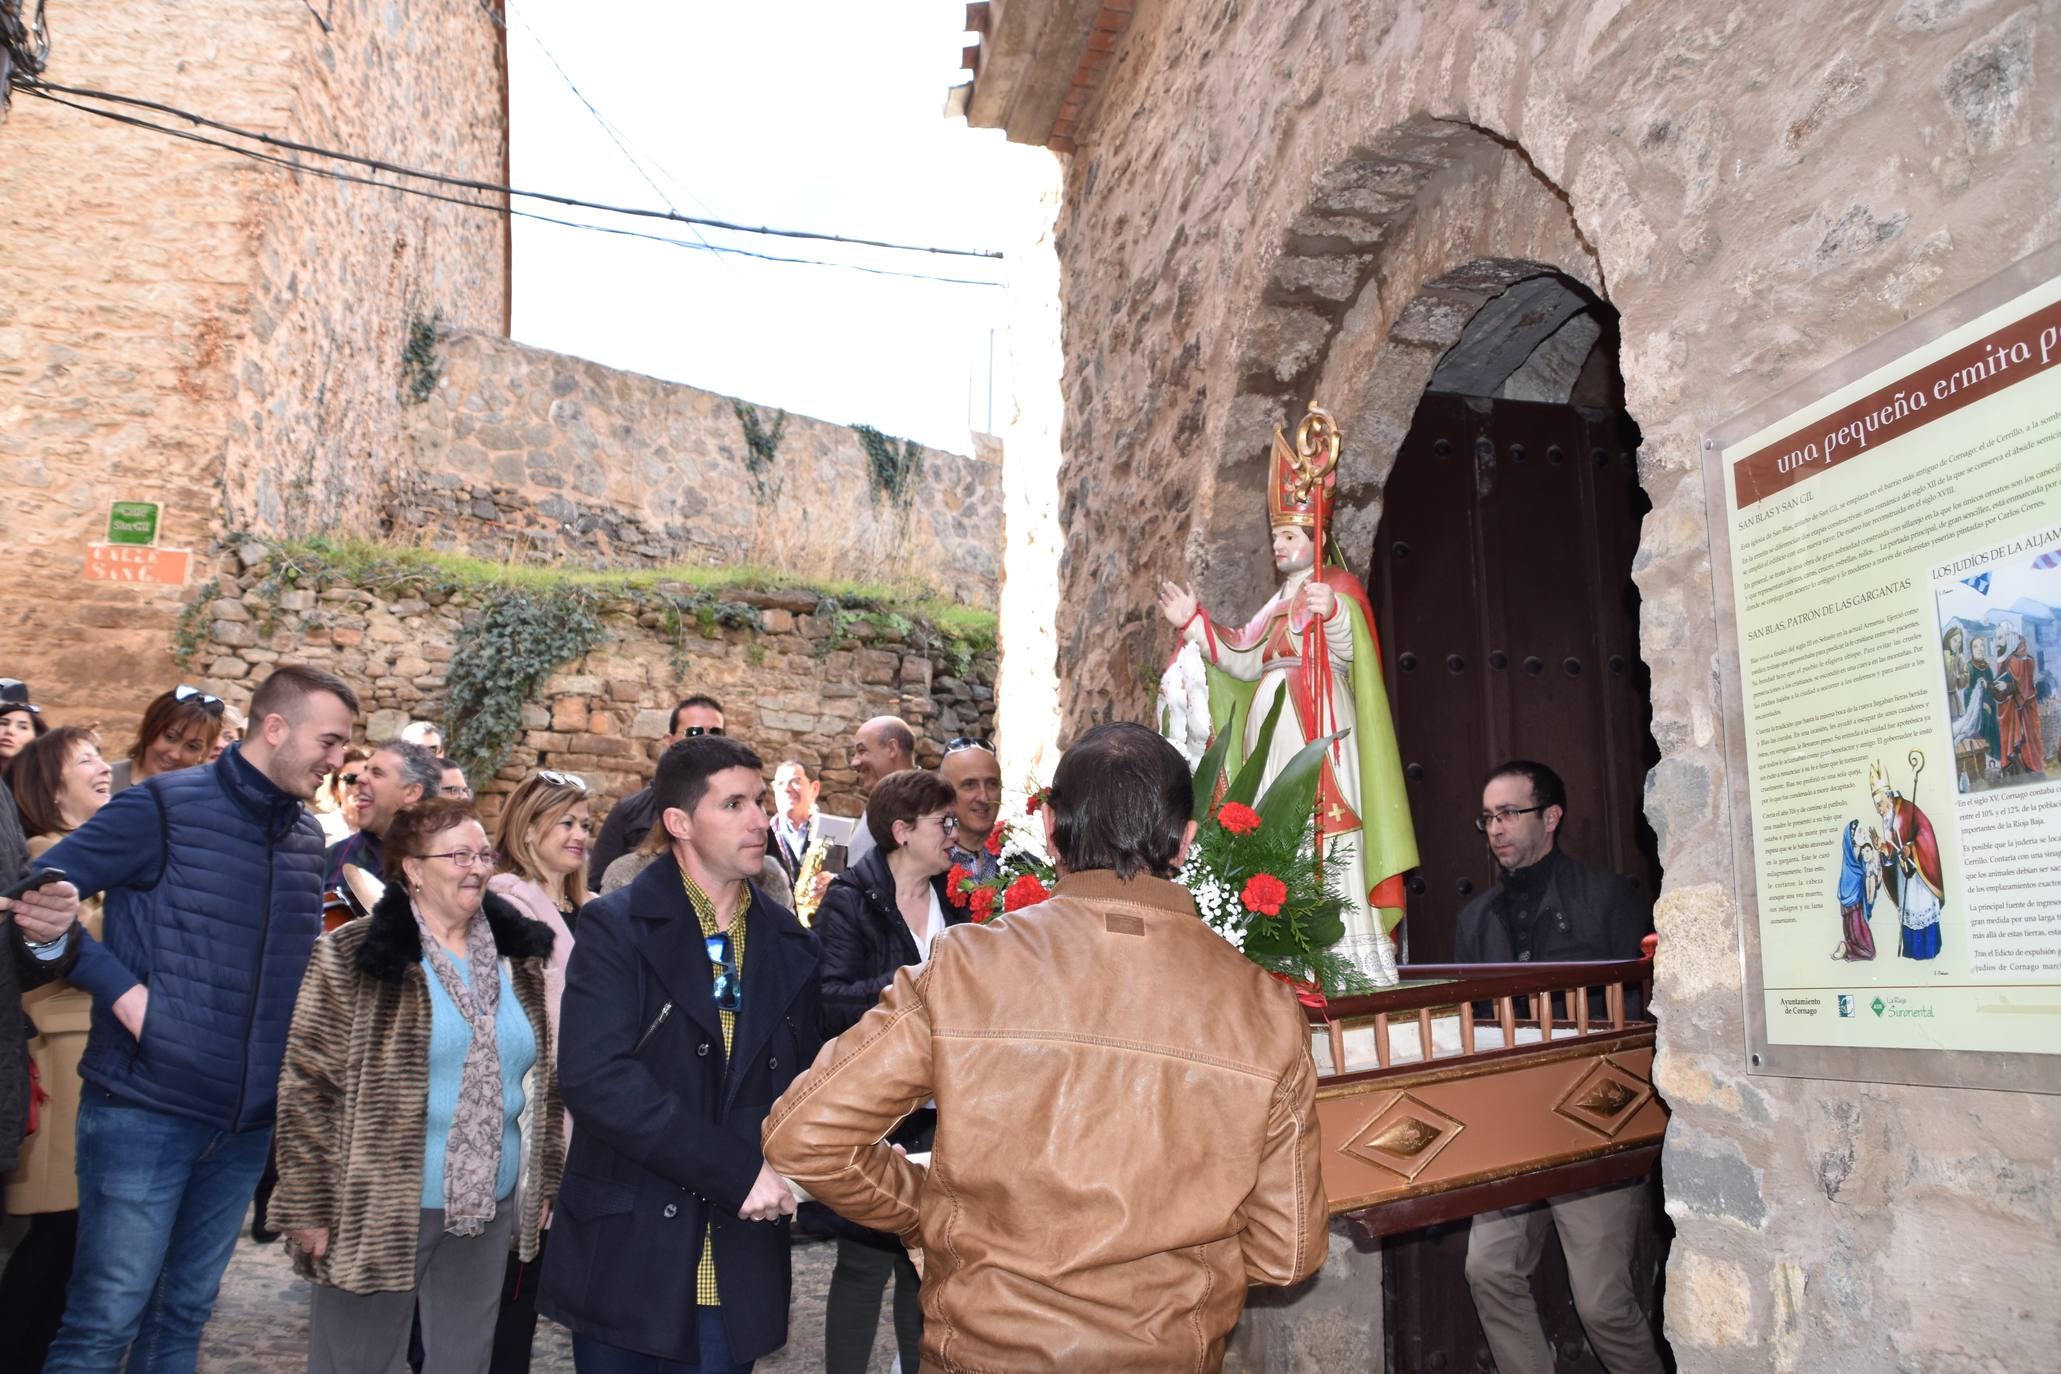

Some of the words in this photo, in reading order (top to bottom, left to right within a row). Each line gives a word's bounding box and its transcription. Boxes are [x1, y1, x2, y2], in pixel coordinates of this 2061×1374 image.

[1777, 443, 1818, 474] una
[1824, 390, 1928, 464] pequeña
[1933, 343, 2031, 401] ermita
[1933, 564, 1951, 580] LOS
[1990, 546, 2006, 561] DE
[2007, 540, 2022, 555] LA
[1748, 628, 1764, 641] SAN
[1822, 604, 1833, 616] DE
[1835, 598, 1852, 612] LAS
[1852, 577, 1912, 606] GARGANTAS
[1974, 797, 1988, 806] siglo
[2001, 792, 2028, 800] Cornago
[2029, 786, 2054, 796] contaba
[2008, 806, 2020, 814] 12%
[2013, 819, 2029, 828] Rioja
[1972, 842, 1992, 852] posible
[1988, 868, 2014, 877] animales
[1978, 902, 2004, 912] principal
[2038, 914, 2055, 922] larga
[2010, 963, 2039, 972] Cornago
[1780, 998, 1820, 1007] Ayuntamiento
[1792, 1006, 1817, 1016] Cornago
